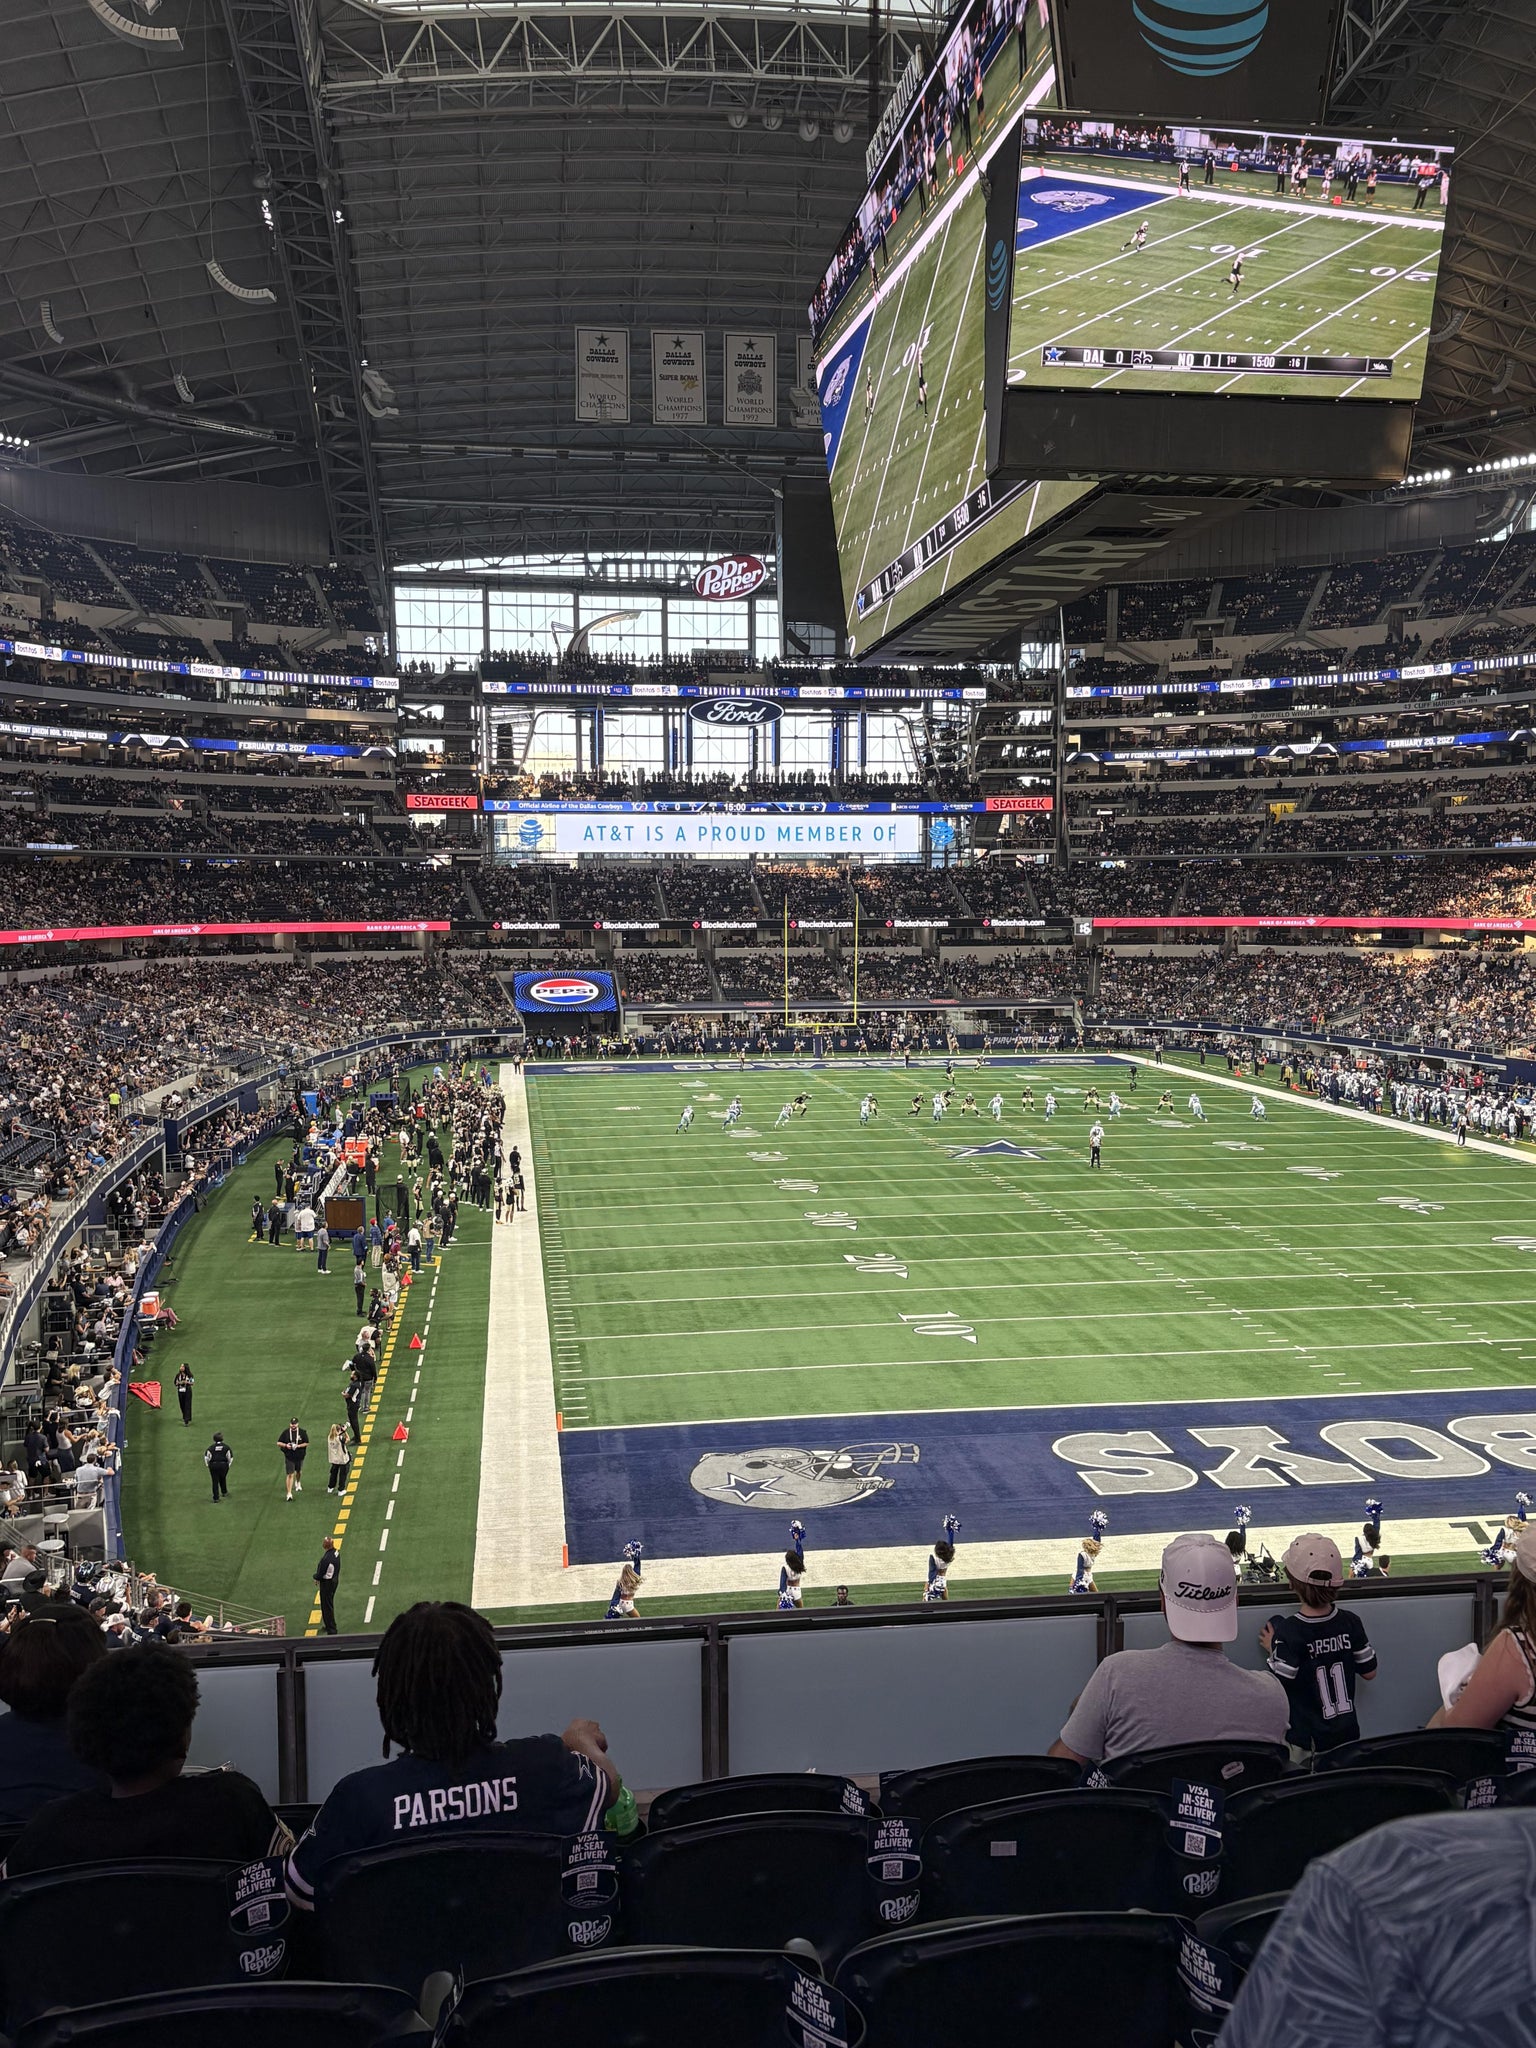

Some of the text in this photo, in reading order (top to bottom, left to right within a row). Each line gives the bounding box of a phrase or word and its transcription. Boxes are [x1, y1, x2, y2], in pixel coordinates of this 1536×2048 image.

[589, 348, 616, 356] DALLAS
[1083, 350, 1123, 364] DAL 0
[1178, 353, 1211, 368] NO 0
[1226, 355, 1300, 369] 1ST 15:00 :16
[659, 373, 678, 381] SUPER
[666, 395, 694, 403] WORLD
[736, 397, 764, 405] WORLD
[657, 403, 702, 411] CHAMPIONS
[728, 405, 773, 414] CHAMPIONS
[1066, 471, 1332, 491] WINSTAR
[953, 503, 969, 531] 15:00
[721, 560, 748, 578] Dr
[702, 564, 762, 597] Pepper
[904, 538, 1170, 654] WINSTAR
[84, 652, 127, 667] TRADITION
[132, 658, 169, 672] MATTERS
[1474, 657, 1518, 670] TRADITION
[263, 671, 309, 683] TRADITION
[314, 674, 351, 685] MATTERS
[1293, 672, 1380, 686] TRADITION MATTERS
[528, 683, 572, 693] TRADITION
[576, 684, 611, 694] MATTERS
[699, 687, 779, 697] TRADITION MATTERS
[864, 688, 943, 698] TRADITION MATTERS
[1112, 685, 1158, 696] TRADITION
[1161, 683, 1198, 694] MATTERS
[705, 700, 766, 722] Ford
[238, 741, 275, 751] FEBRUARY
[289, 743, 308, 752] 2027
[1386, 738, 1423, 748] FEBRUARY
[1437, 736, 1455, 744] 2027
[1130, 751, 1156, 759] FEDERAL
[414, 795, 470, 808] SEATGEEK
[597, 802, 623, 810] Cowboys
[674, 803, 680, 811] 0
[724, 802, 746, 811] 15:00
[799, 803, 805, 811] 0
[992, 798, 1045, 809] SEATGEEK
[583, 825, 896, 841] AT&T IS A PROUD MEMBER OF
[501, 921, 560, 930] Blockchain.com
[602, 921, 659, 930] Blockchain.com
[701, 921, 757, 929] Blockchain.com
[894, 919, 948, 928] Blockchain.com
[991, 919, 1045, 927] Blockchain.com
[535, 987, 594, 996] PEPSI
[843, 1252, 908, 1274] 20
[897, 1310, 975, 1337] 10
[1174, 1581, 1232, 1601] Titleist
[1316, 1661, 1353, 1720] 11
[846, 1783, 860, 1797] VISA
[1187, 1784, 1210, 1797] VISA
[394, 1776, 517, 1830] PARSONS
[843, 1790, 864, 1806] IN-SEAT
[1182, 1793, 1215, 1810] IN-SEAT
[1178, 1803, 1217, 1823] DELIVERY
[882, 1819, 904, 1829] VISA
[576, 1833, 599, 1843] VISA
[877, 1828, 910, 1839] IN-SEAT
[572, 1840, 605, 1854] IN-SEAT
[874, 1838, 913, 1850] DELIVERY
[568, 1850, 608, 1864] DELIVERY
[241, 1861, 265, 1876] VISA
[237, 1868, 272, 1889] IN-SEAT
[1199, 1870, 1216, 1884] Dr
[235, 1877, 277, 1901] DELIVERY
[884, 1896, 919, 1921] Pepper
[897, 1895, 912, 1908] Dr
[572, 1920, 608, 1944] Pepper
[581, 1919, 600, 1931] Dr
[254, 1945, 273, 1960] Dr
[1184, 1932, 1209, 1959] VISA
[243, 1944, 282, 1973] Pepper
[1182, 1940, 1217, 1976] IN-SEAT
[1179, 1951, 1223, 1992] DELIVERY
[796, 1971, 824, 1997] VISA
[794, 1980, 831, 2013] IN-SEAT
[791, 1990, 836, 2029] DELIVERY
